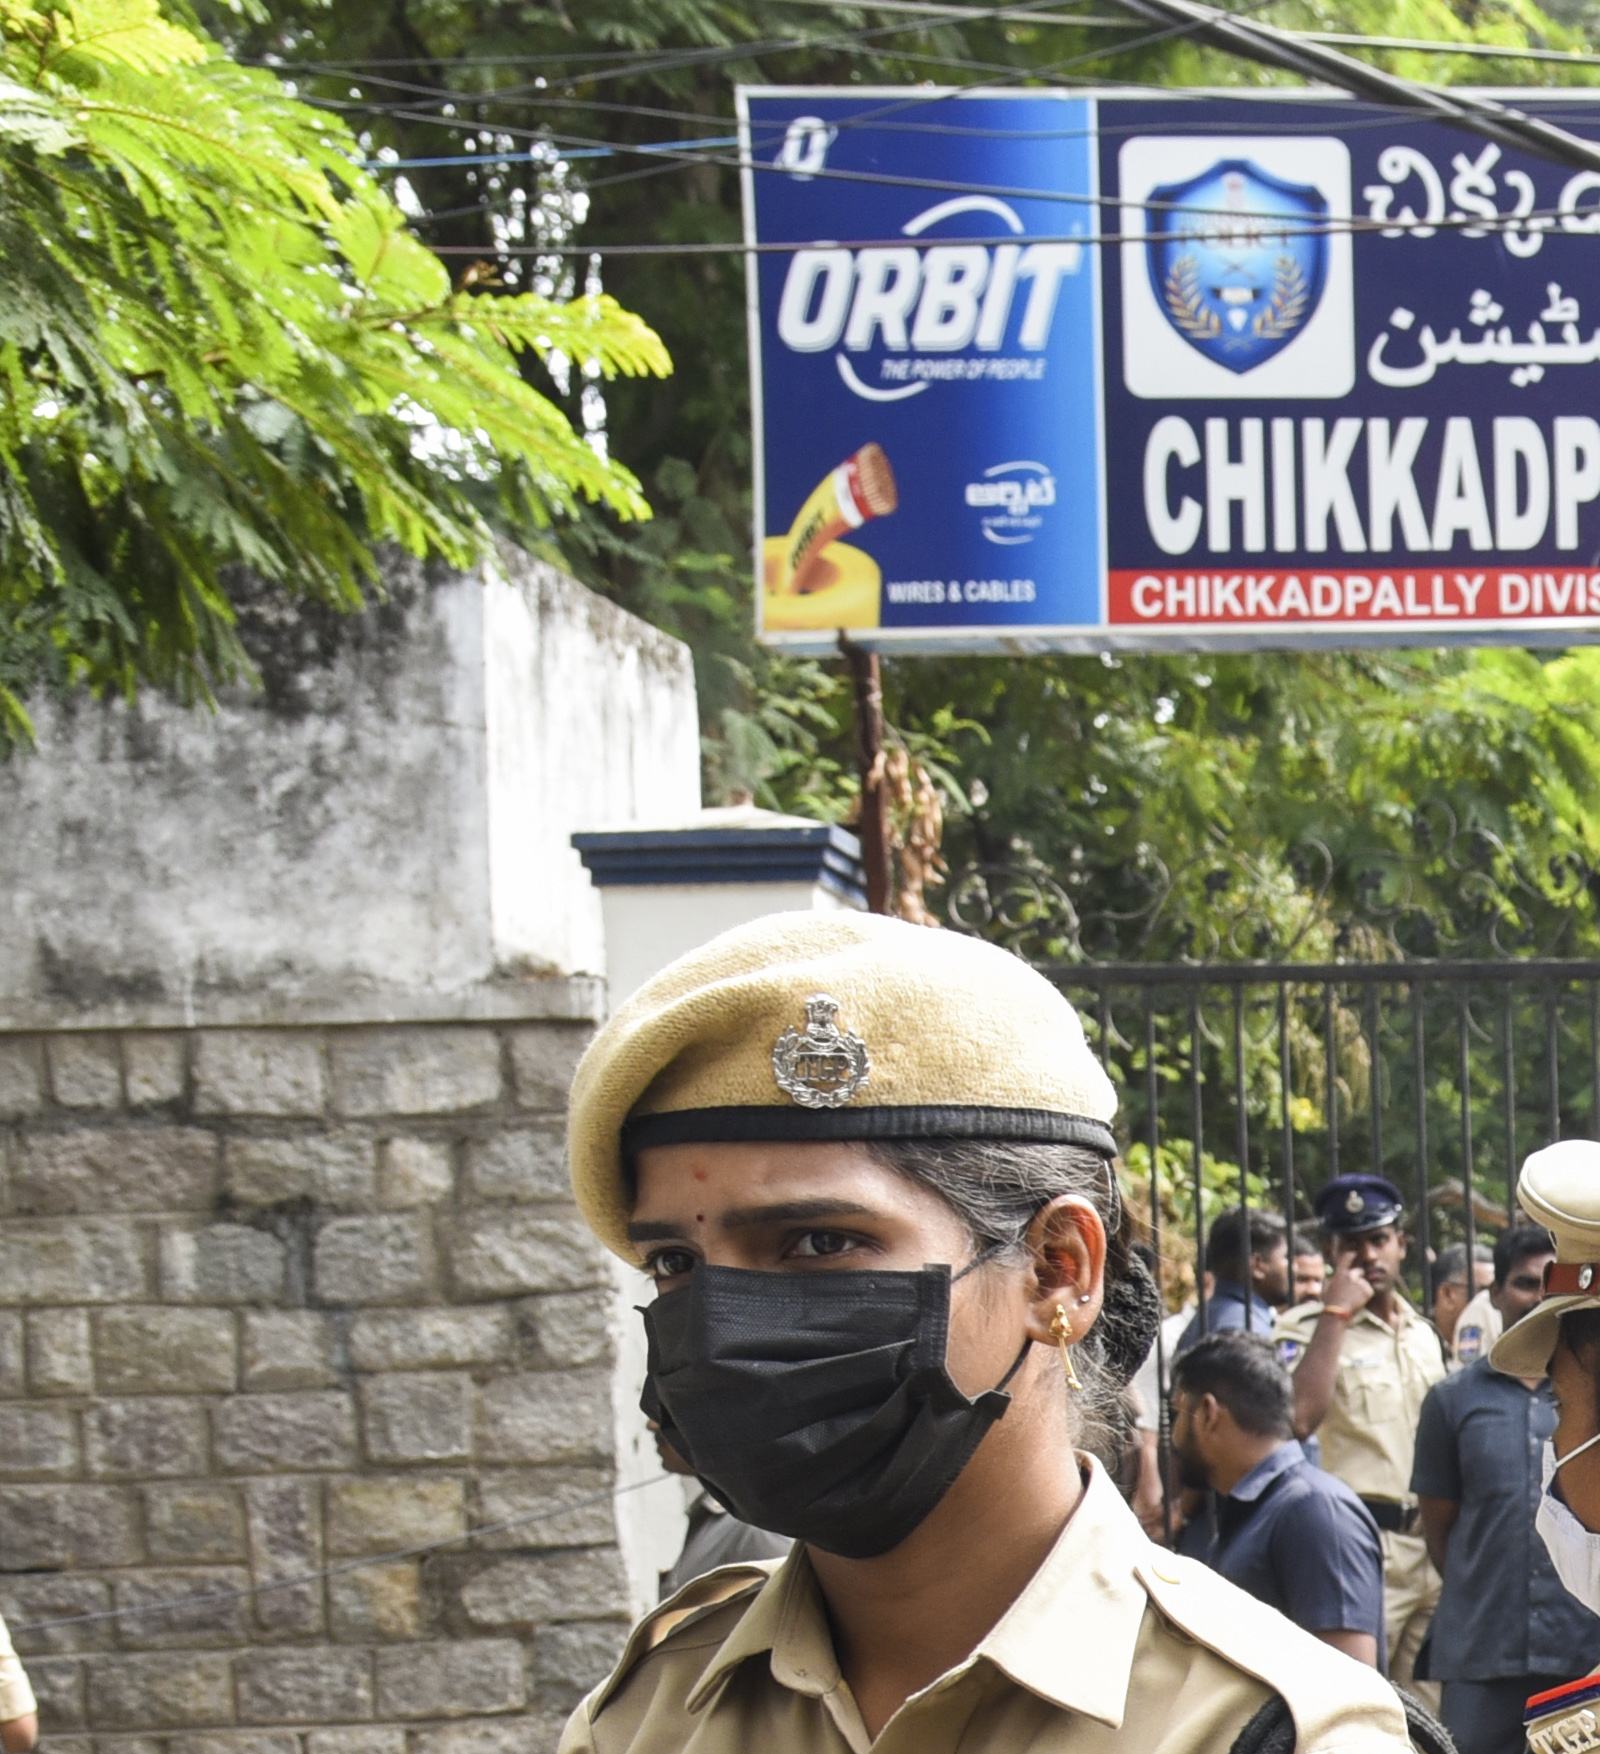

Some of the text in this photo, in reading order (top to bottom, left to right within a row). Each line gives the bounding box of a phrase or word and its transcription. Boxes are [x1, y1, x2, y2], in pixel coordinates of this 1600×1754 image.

[777, 242, 1084, 353] ORBIT
[886, 579, 1037, 603] WIRES & CABLES
[1130, 574, 1487, 618] CHIKKADPALLY
